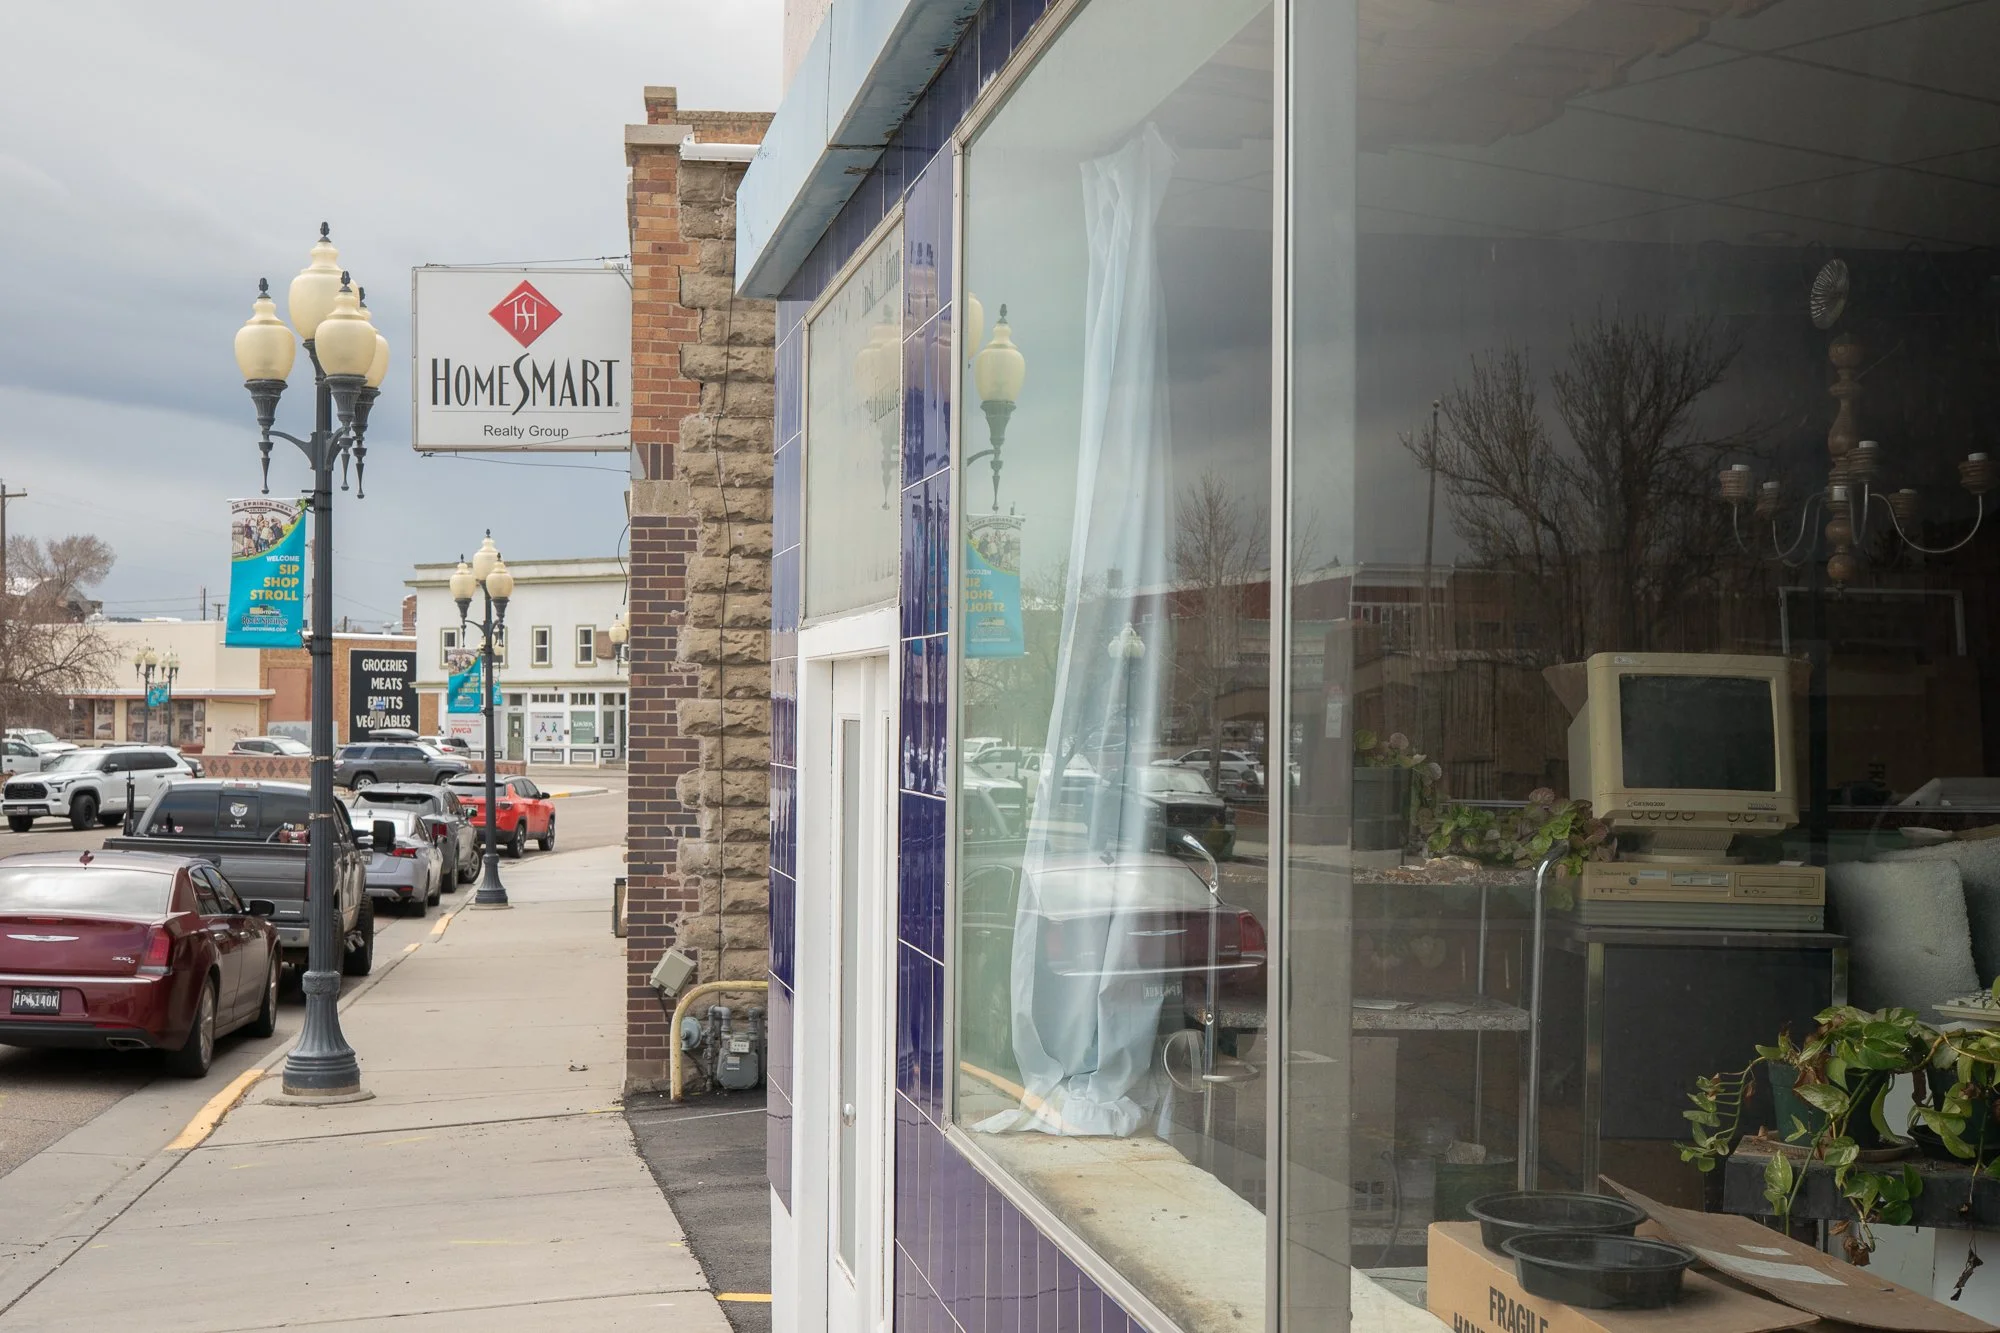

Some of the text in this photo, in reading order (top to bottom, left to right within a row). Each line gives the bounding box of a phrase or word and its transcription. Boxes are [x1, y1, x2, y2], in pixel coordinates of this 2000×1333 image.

[483, 425, 569, 440] Realty Group
[279, 564, 300, 575] SIP
[263, 577, 299, 588] SHOP
[249, 589, 299, 601] STROLL
[361, 658, 408, 672] GROCERIES
[371, 677, 402, 690] MEATS
[356, 714, 411, 728] VEGTABLES
